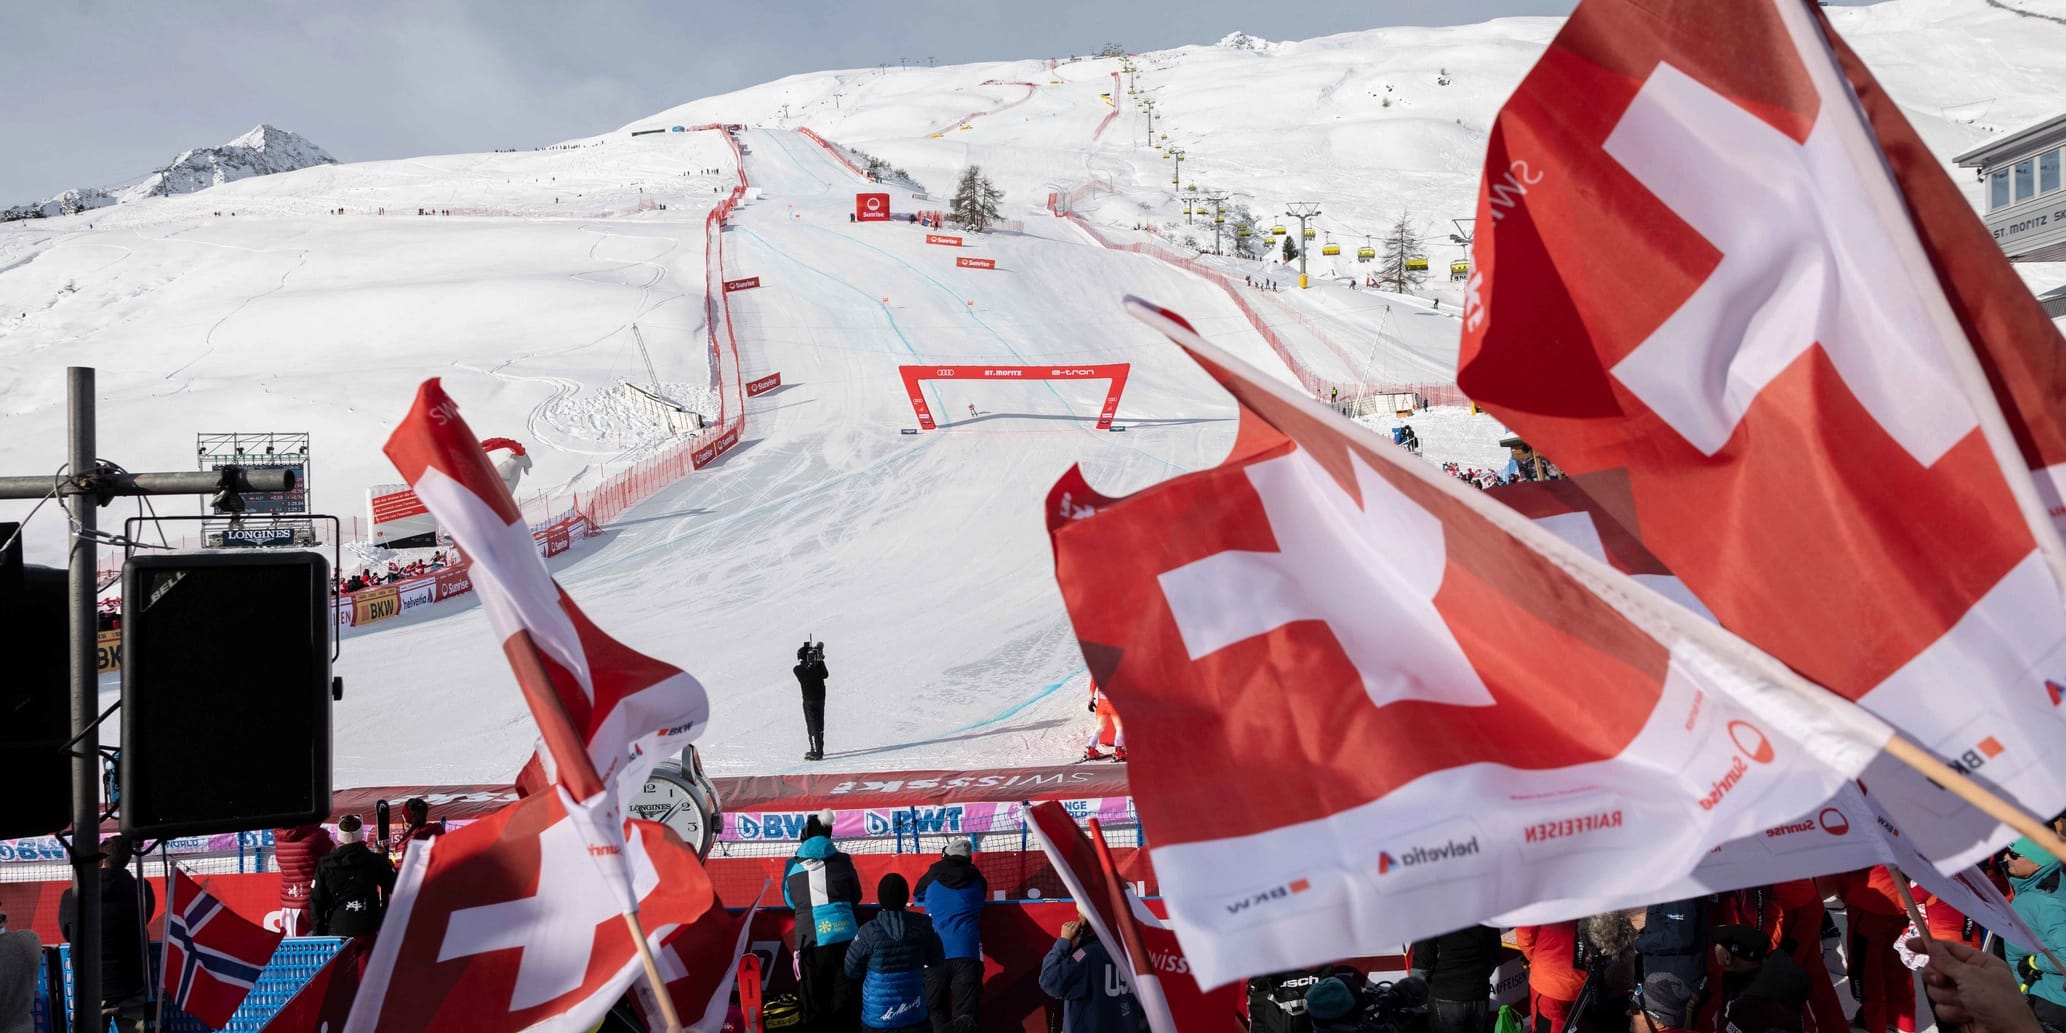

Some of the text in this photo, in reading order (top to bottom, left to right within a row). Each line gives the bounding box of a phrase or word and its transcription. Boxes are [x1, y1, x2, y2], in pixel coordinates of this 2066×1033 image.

[937, 236, 958, 245] Sunrise
[968, 259, 990, 267] Sunrise
[735, 279, 755, 289] Sunrise
[757, 377, 776, 390] Sunrise
[228, 530, 291, 540] LONGINES
[150, 570, 187, 603] BELL
[448, 580, 469, 594] Sunrise
[370, 599, 394, 620] BKW
[403, 596, 426, 610] helvetia
[97, 645, 122, 670] BK
[668, 721, 694, 736] BKW
[644, 784, 656, 793] 12
[629, 803, 672, 812] LONGINES
[681, 803, 691, 812] 2
[762, 813, 811, 838] BW
[891, 806, 963, 833] BWT
[687, 823, 698, 833] 3
